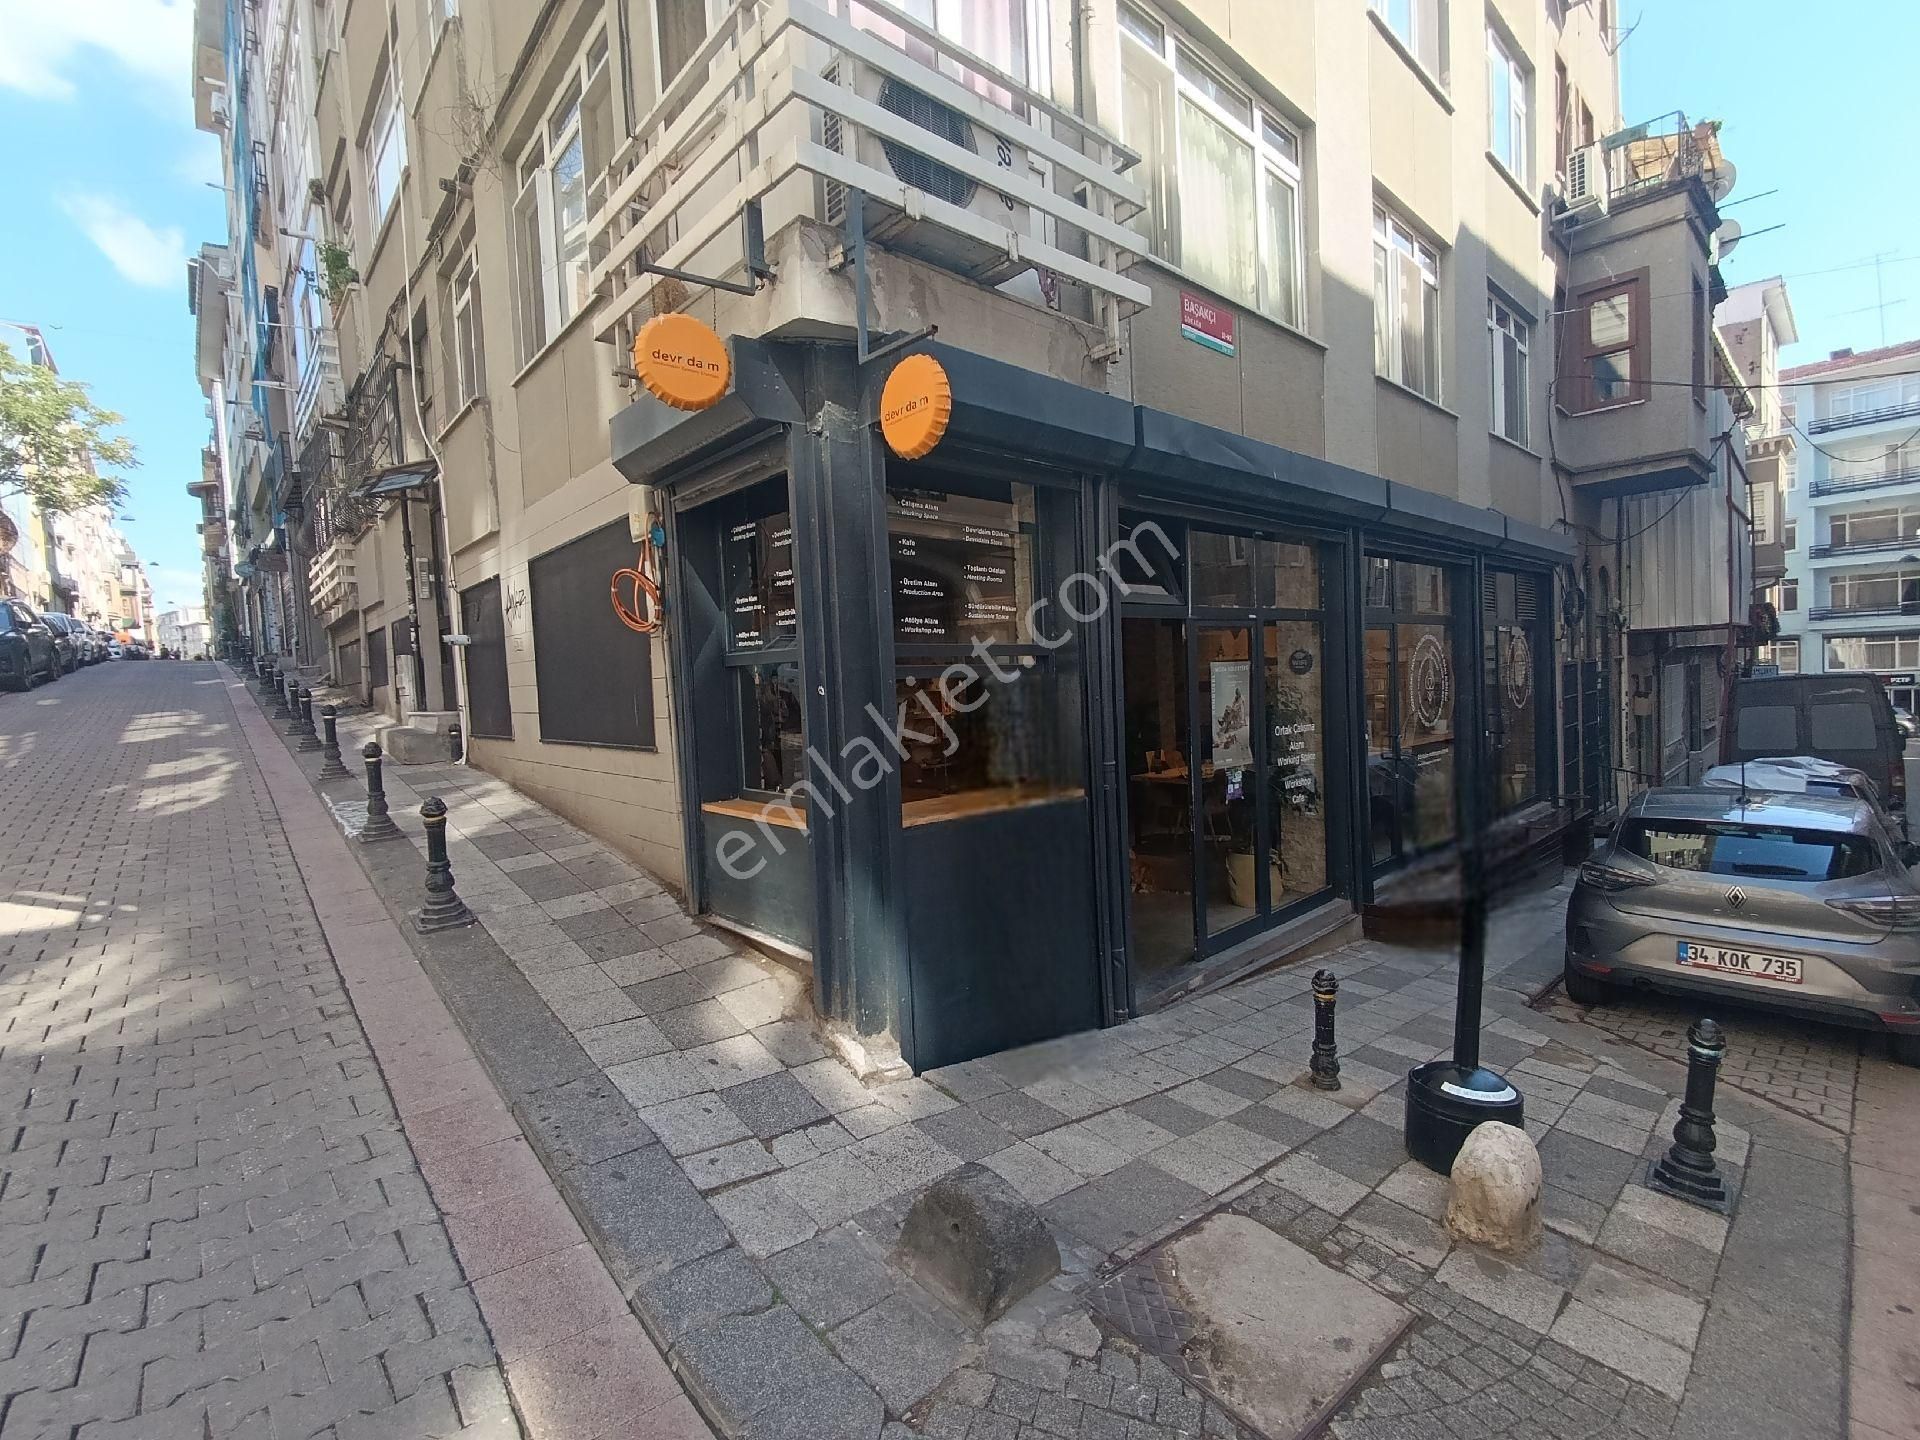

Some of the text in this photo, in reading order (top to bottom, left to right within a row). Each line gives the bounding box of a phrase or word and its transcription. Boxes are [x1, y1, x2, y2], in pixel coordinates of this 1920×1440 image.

[1184, 299, 1216, 325] BAŞAKÇI
[903, 588, 931, 597] Production
[904, 627, 945, 635] Workshop Area
[1284, 777, 1312, 790] Workshop
[1688, 946, 1709, 962] 34
[1717, 950, 1751, 970] KOK
[1761, 958, 1797, 977] 735
